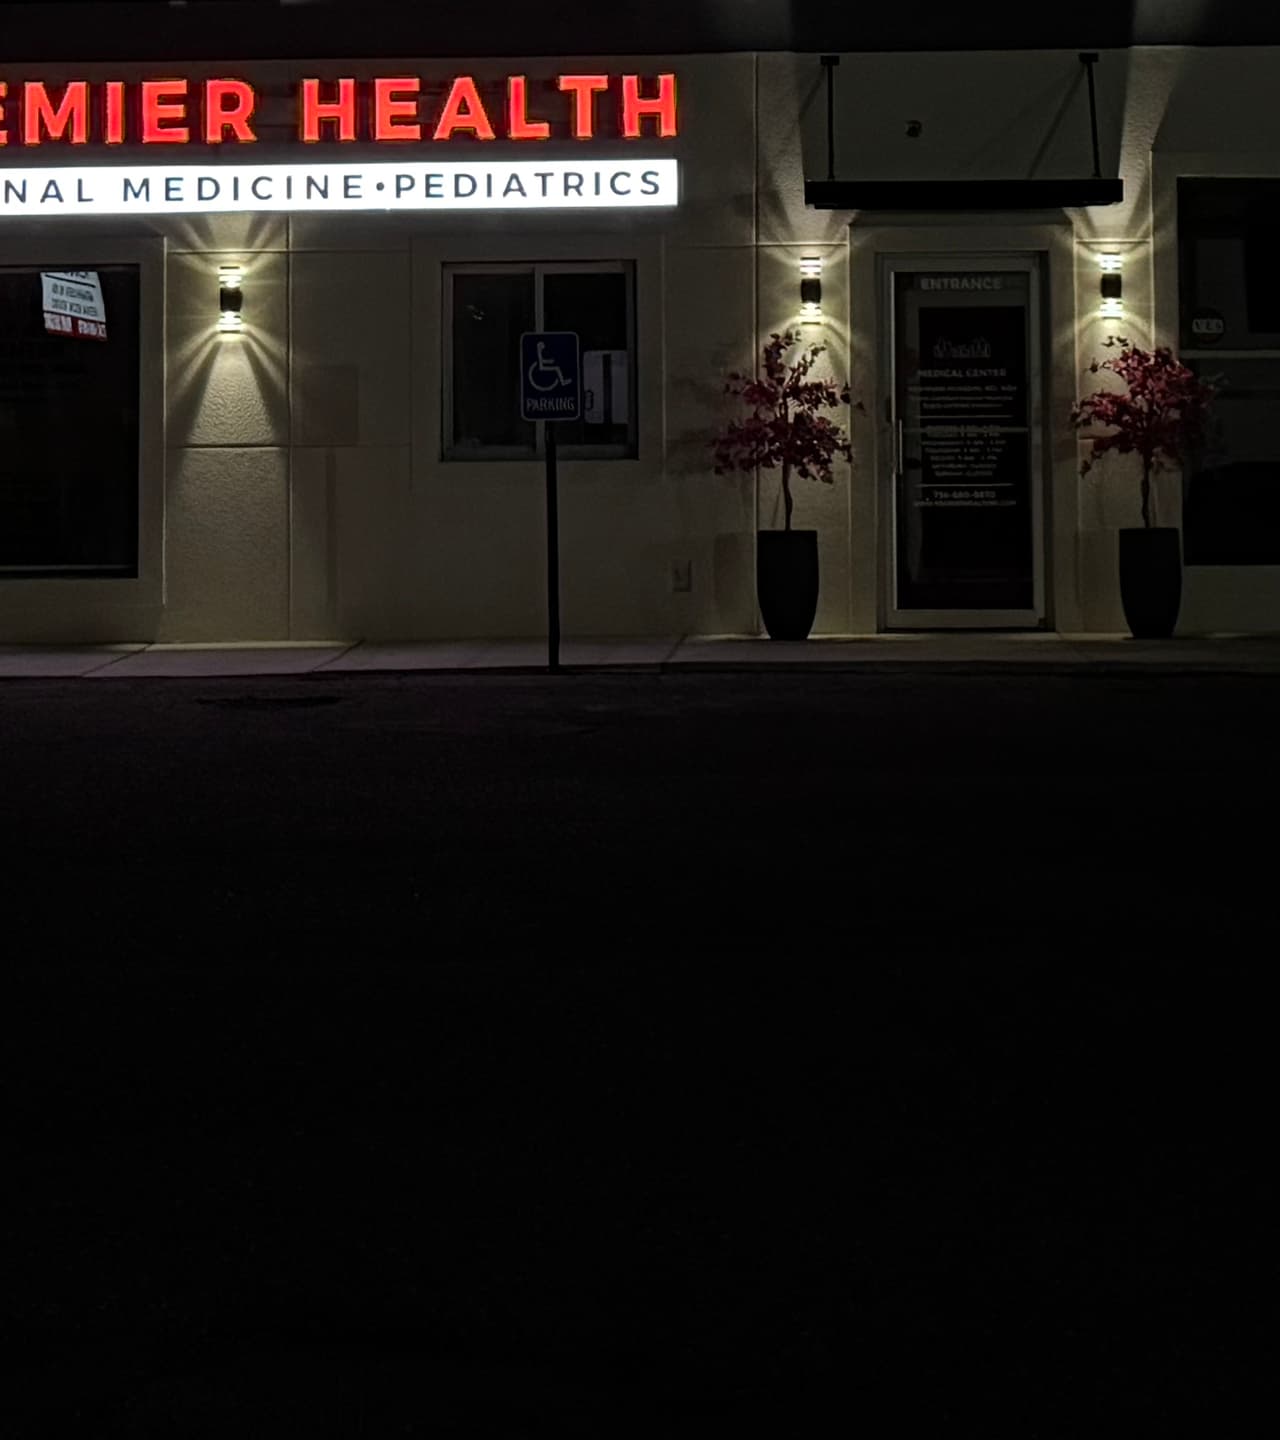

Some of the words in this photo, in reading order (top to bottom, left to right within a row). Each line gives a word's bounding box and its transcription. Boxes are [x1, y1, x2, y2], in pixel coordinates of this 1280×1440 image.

[301, 73, 677, 142] HEALTH
[920, 277, 1004, 290] ENTRANCE
[525, 396, 577, 413] PARKING
